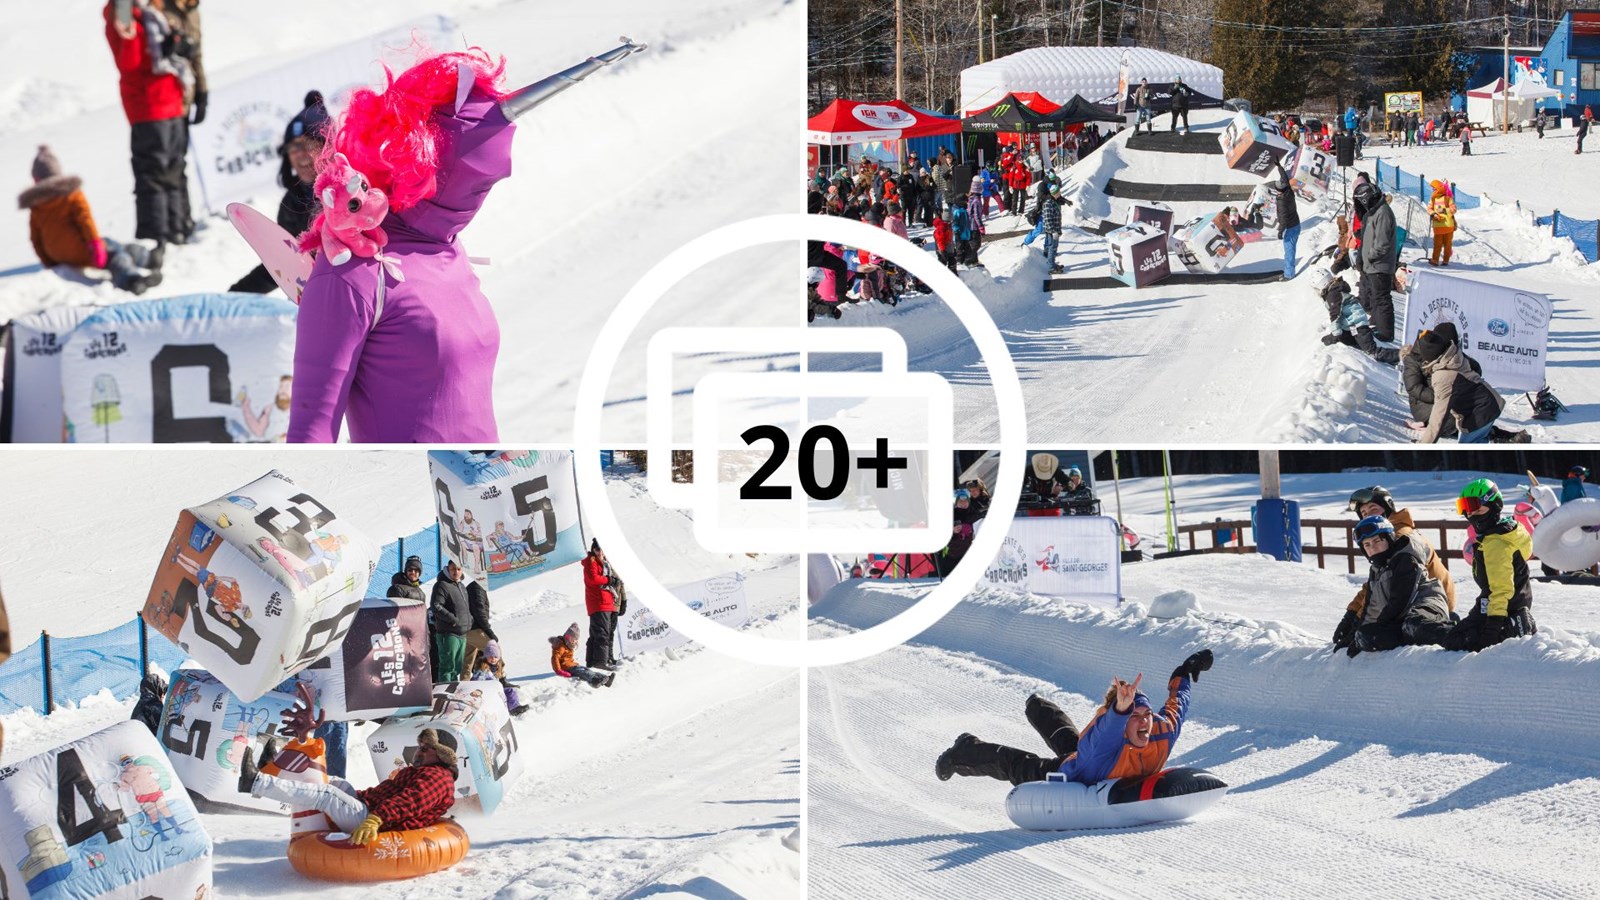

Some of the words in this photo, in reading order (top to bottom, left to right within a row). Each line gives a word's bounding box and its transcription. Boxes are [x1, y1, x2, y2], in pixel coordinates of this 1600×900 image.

[1310, 152, 1326, 179] 3
[1151, 249, 1162, 263] 12
[1419, 311, 1429, 325] LA
[1427, 297, 1460, 315] DESCENTE
[41, 332, 56, 346] 12
[102, 332, 118, 347] 12
[1478, 341, 1515, 354] BEAUCE
[1516, 348, 1539, 357] AUTO
[489, 485, 498, 494] 12
[511, 475, 557, 557] 5
[1062, 562, 1108, 573] SAINT-GEORGES
[271, 605, 283, 617] 12
[713, 604, 738, 614] AUTO
[627, 620, 669, 640] CABOCHONS
[371, 633, 394, 660] 12
[381, 662, 396, 685] LES
[162, 719, 211, 760] 5
[378, 741, 385, 749] 12
[57, 748, 124, 848] 4
